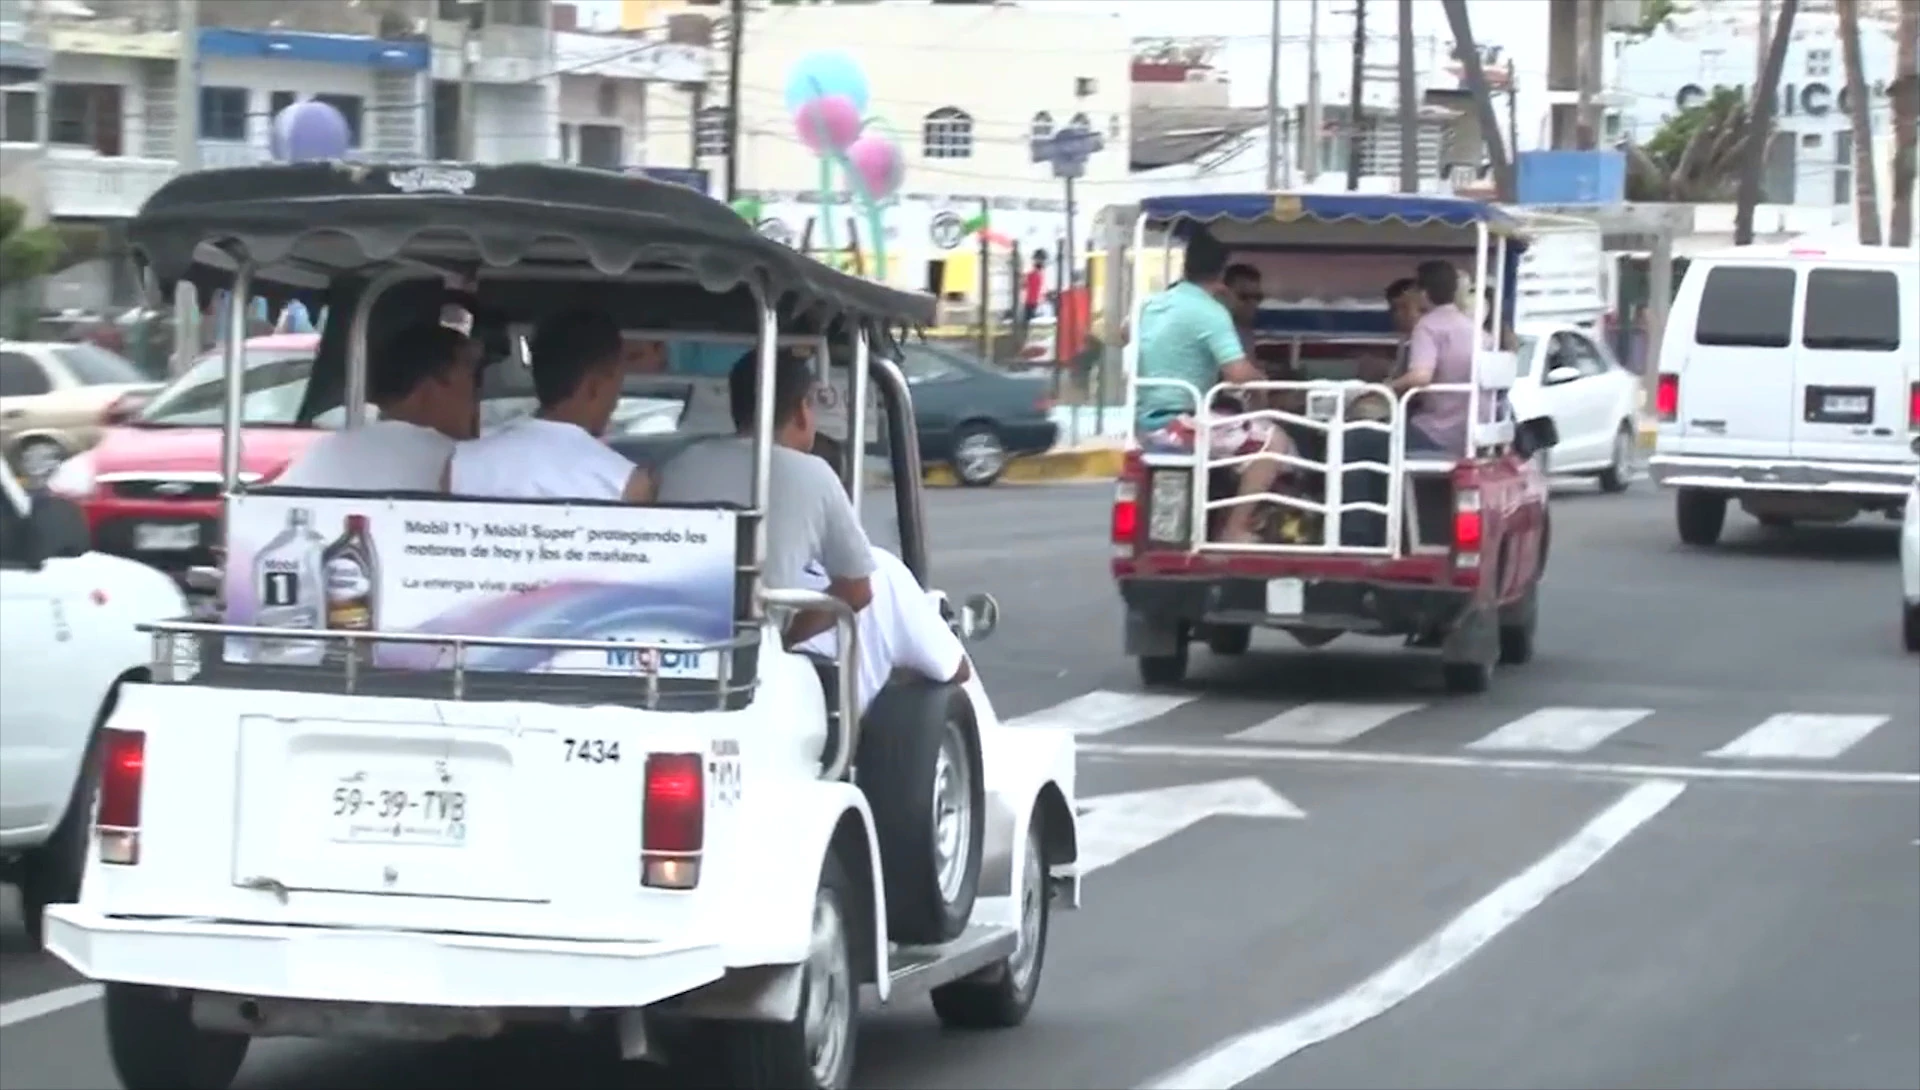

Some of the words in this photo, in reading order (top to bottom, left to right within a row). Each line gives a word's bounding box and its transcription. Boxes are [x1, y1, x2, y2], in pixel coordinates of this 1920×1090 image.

[404, 519, 449, 534] Mobil
[484, 522, 528, 537] Mobil
[587, 528, 682, 545] protegiendo
[685, 529, 707, 544] los
[405, 543, 467, 557] motores
[470, 545, 489, 558] de
[493, 545, 520, 563] hoy
[539, 543, 561, 560] los
[565, 549, 583, 561] de
[271, 575, 288, 604] 1
[563, 738, 620, 763] 7434
[333, 788, 466, 821] 59-39-TVB
